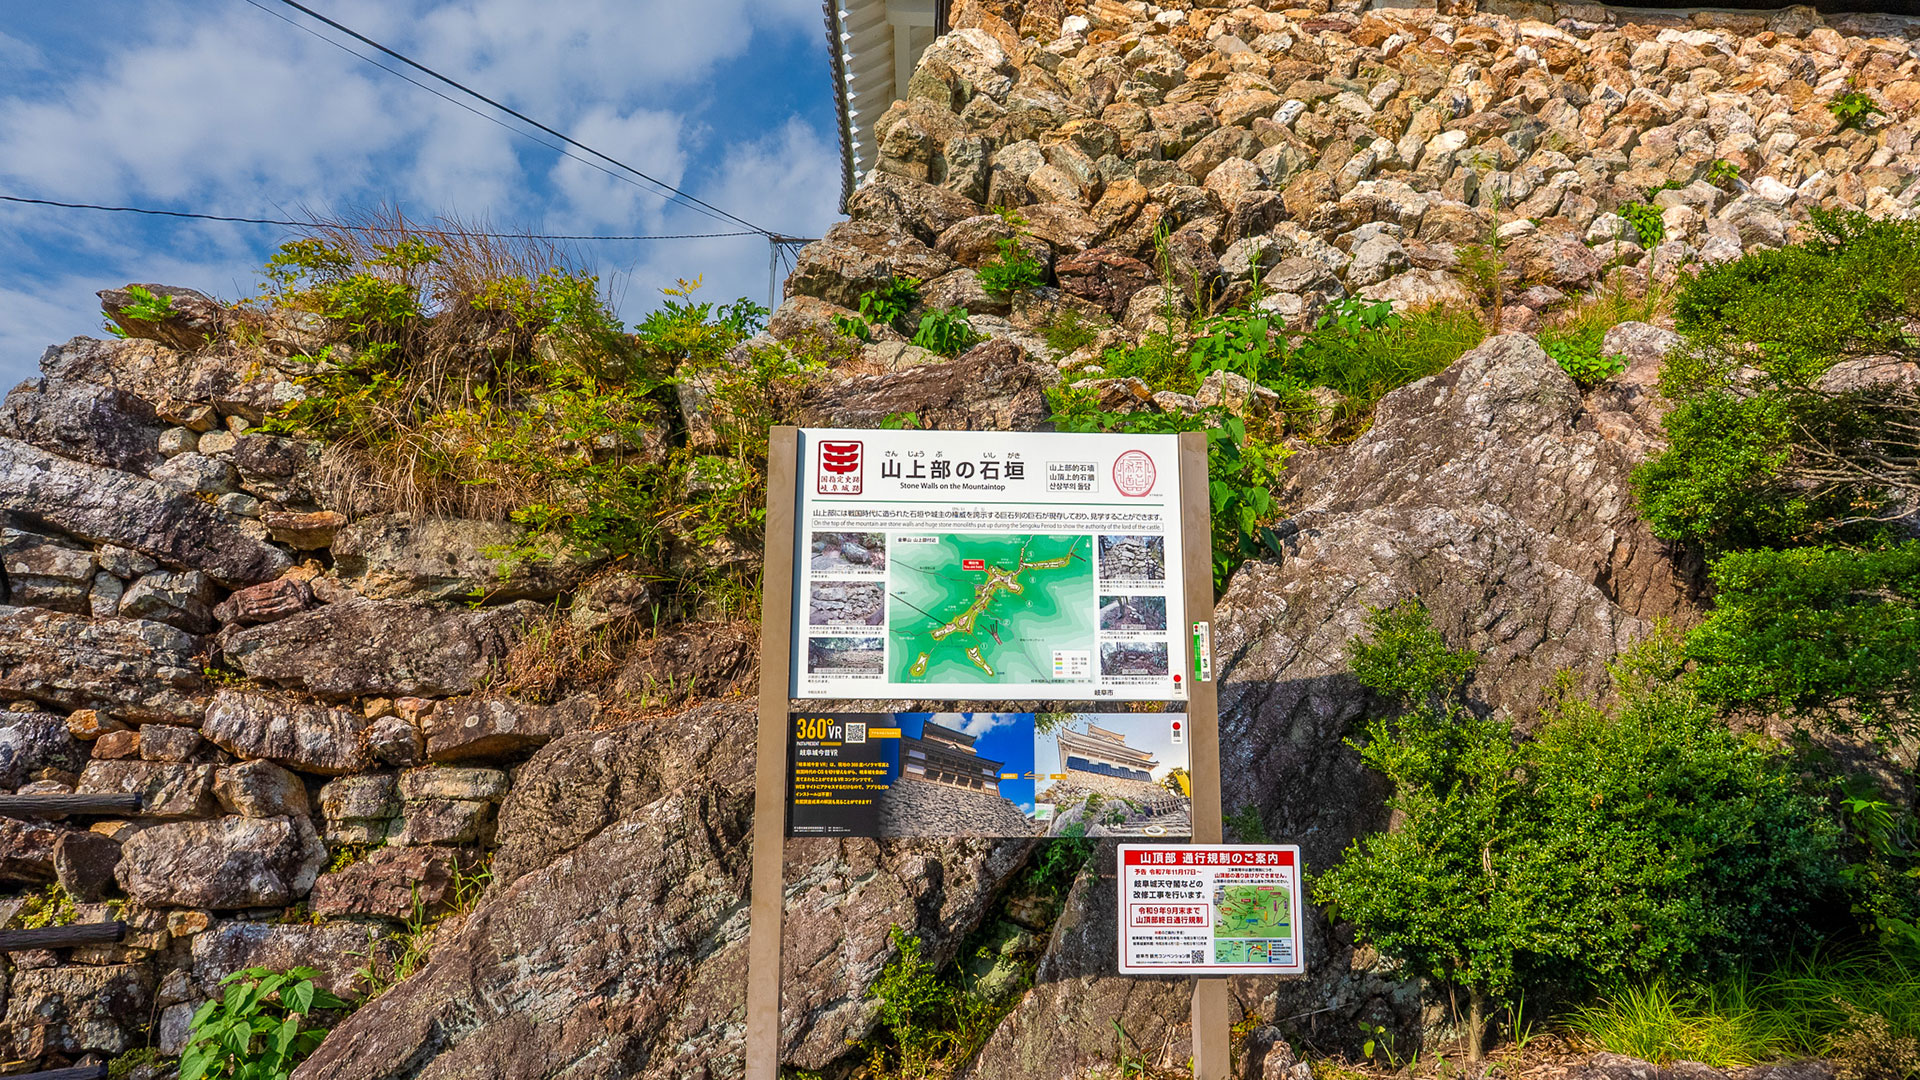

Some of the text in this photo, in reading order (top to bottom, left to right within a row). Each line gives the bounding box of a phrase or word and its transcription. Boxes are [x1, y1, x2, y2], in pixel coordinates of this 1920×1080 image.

[881, 459, 1025, 481] 山上部の石垣
[900, 482, 920, 490] Stone
[920, 482, 939, 490] Walls
[962, 483, 1006, 492] Mountaintop
[827, 725, 842, 740] VR
[1140, 851, 1279, 865] 山頂部 通行規制のご案内
[1134, 868, 1147, 876] 予告
[1133, 880, 1204, 888] 岐阜城天守閣などの
[1132, 891, 1206, 899] 改修工事を行います。
[1138, 906, 1201, 915] 令和9年9月末まで
[1135, 916, 1204, 924] 山頂部終日通行規制
